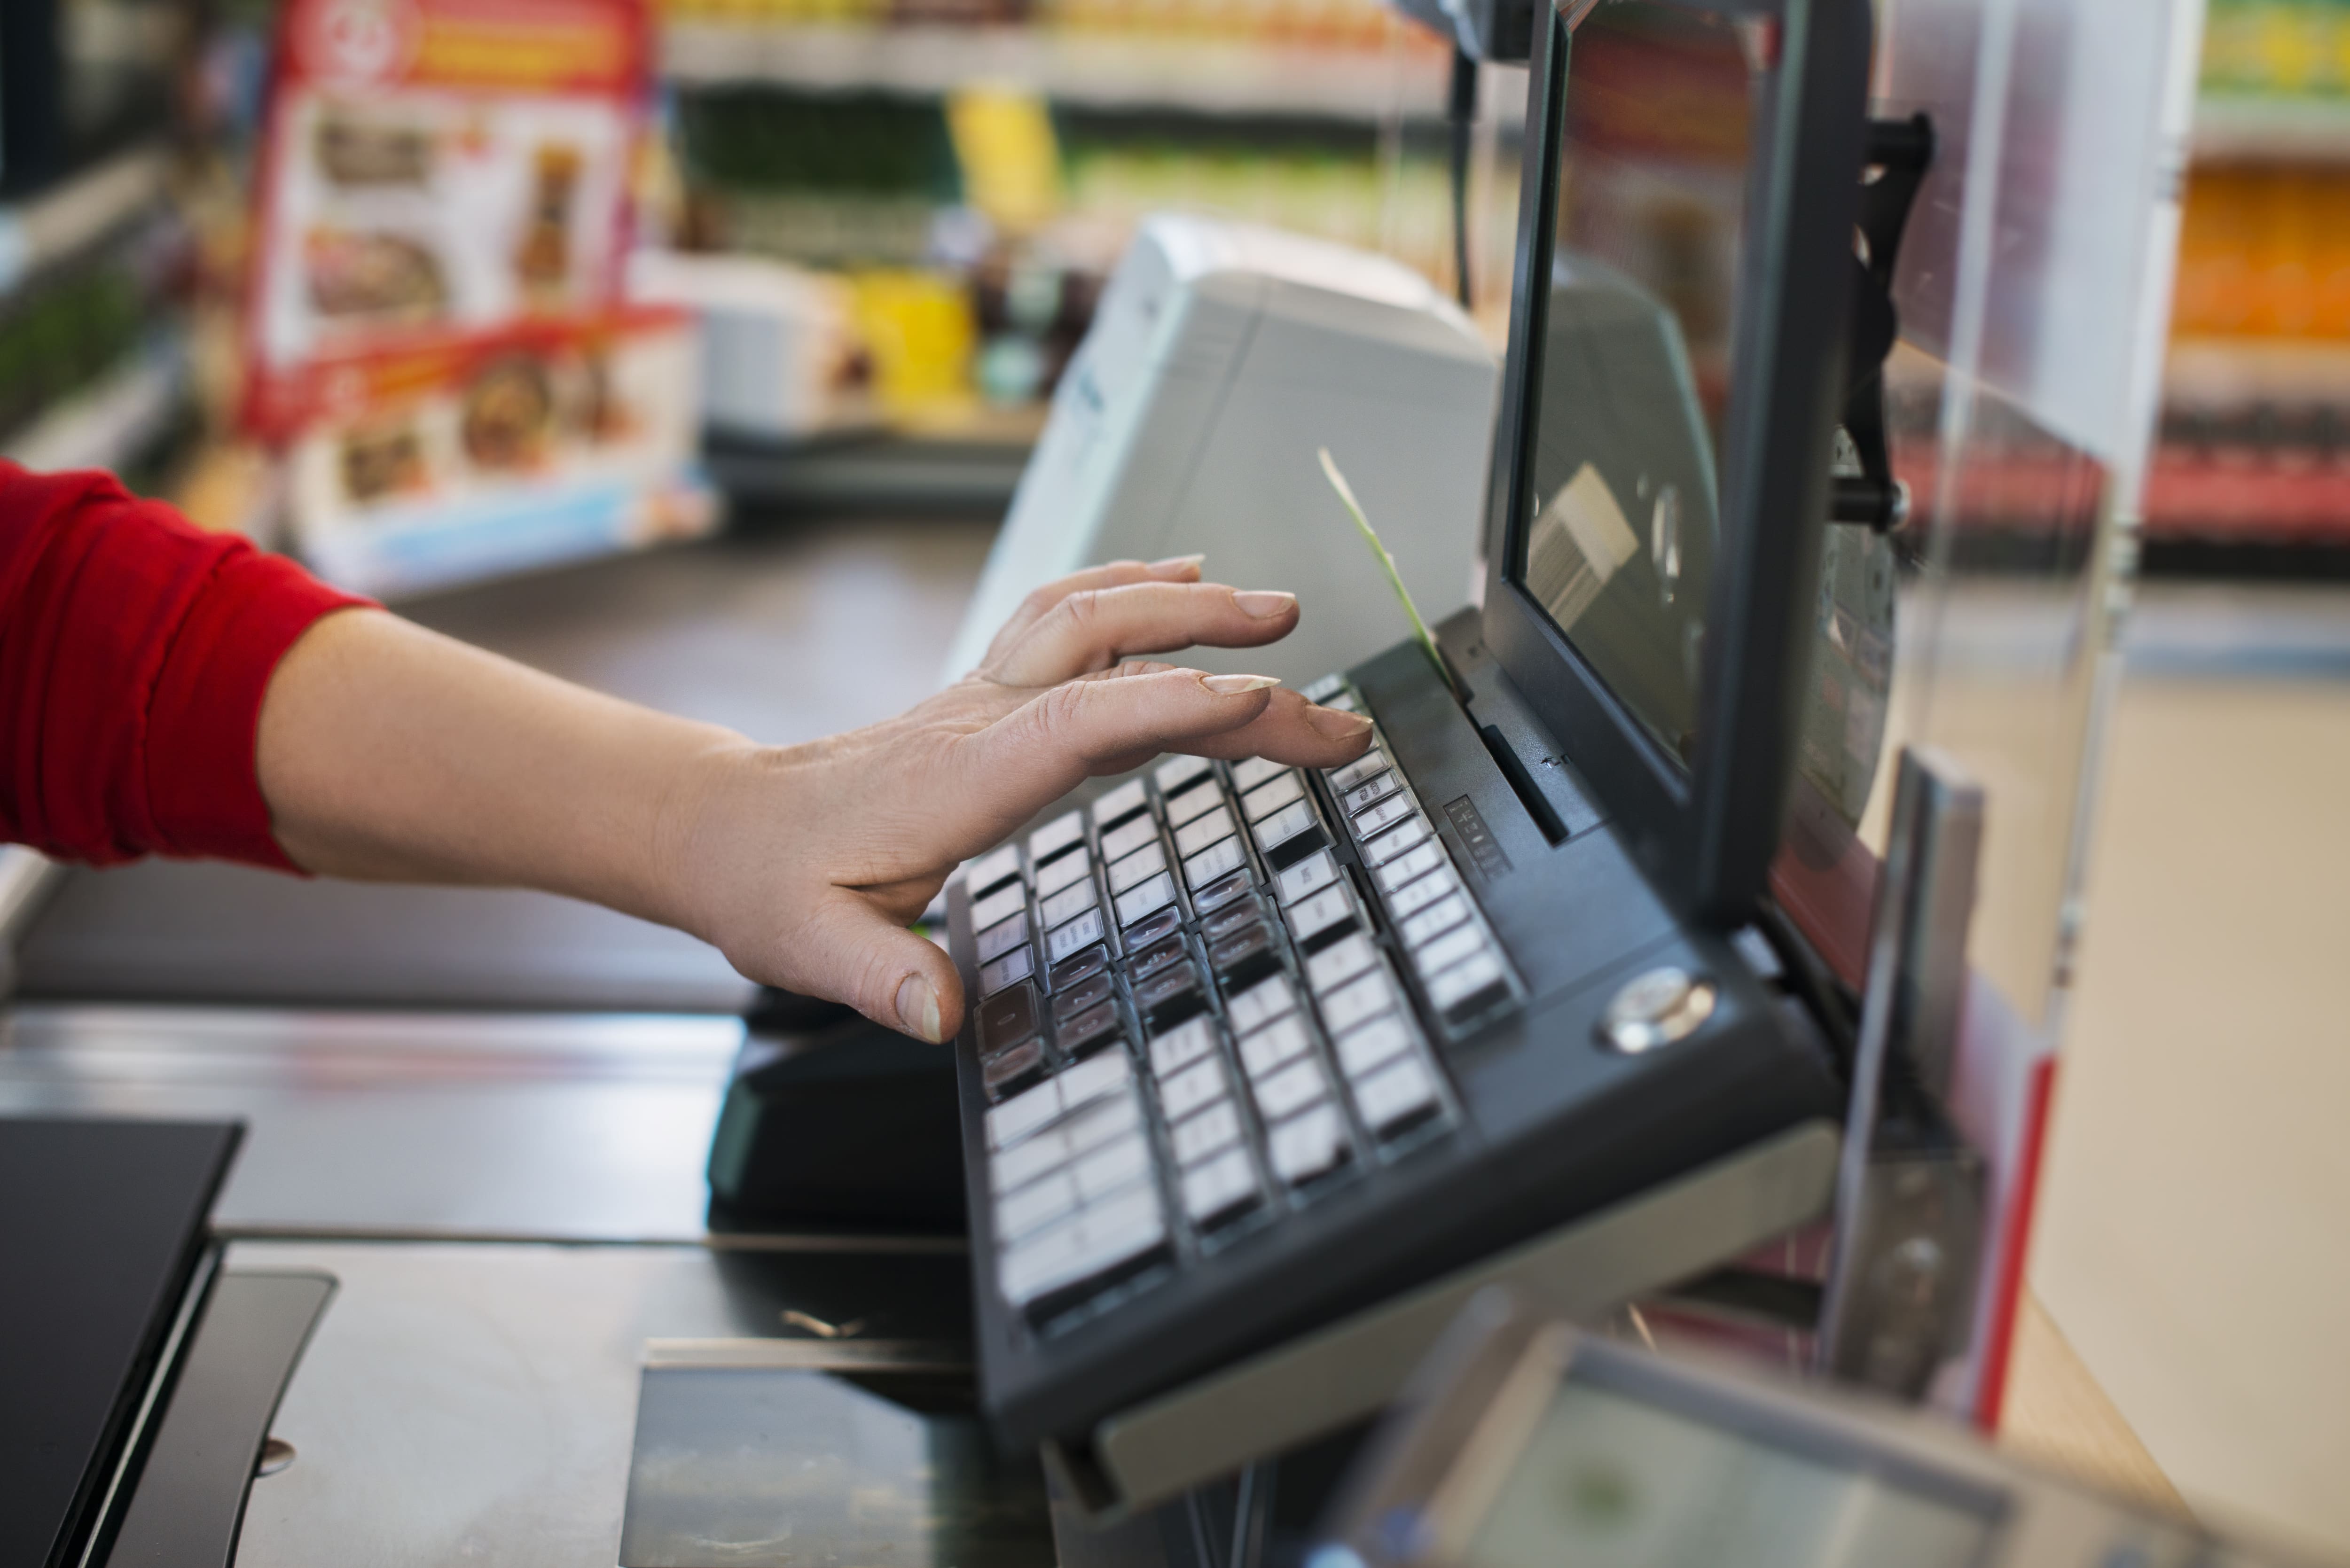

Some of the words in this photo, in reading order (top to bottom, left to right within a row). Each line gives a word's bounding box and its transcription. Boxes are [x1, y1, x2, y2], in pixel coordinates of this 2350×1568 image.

[1214, 887, 1232, 898] 7
[1142, 927, 1159, 938] 4
[1069, 965, 1087, 976] 1
[1073, 991, 1093, 1005] 2
[996, 1013, 1016, 1026] 0
